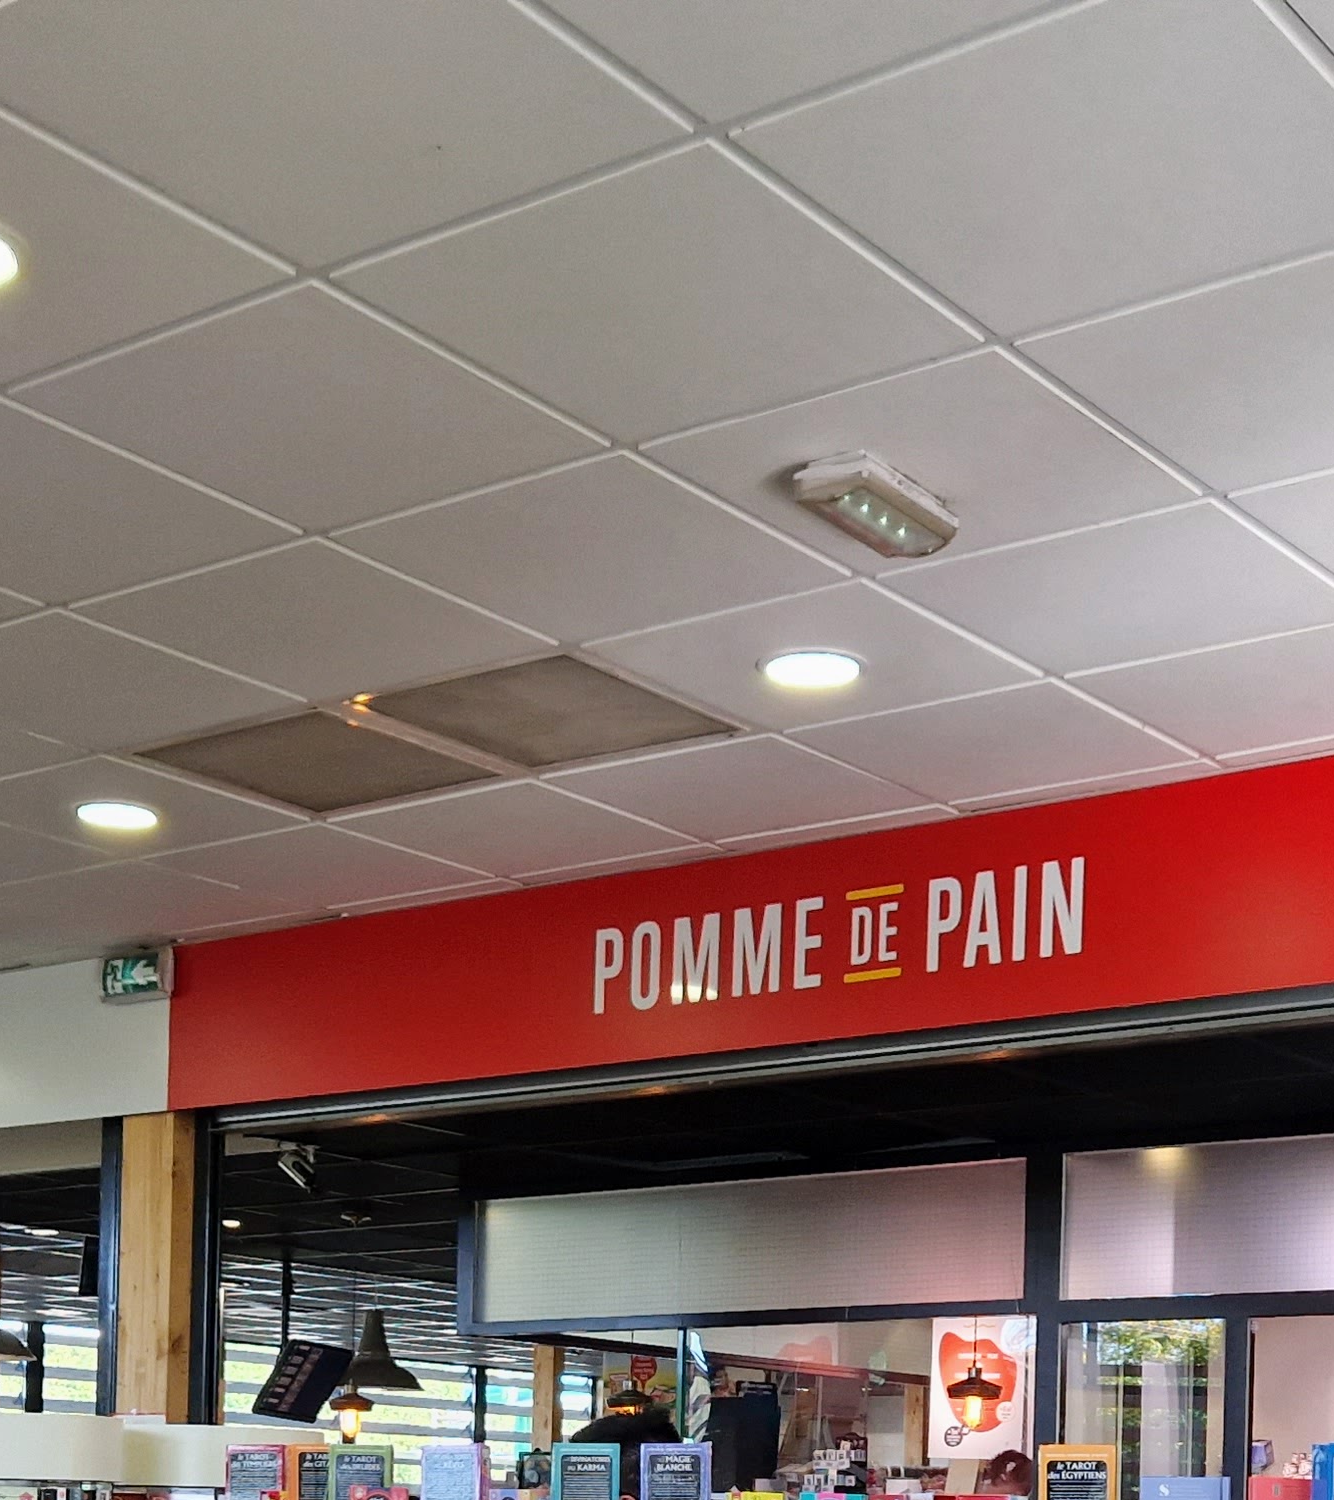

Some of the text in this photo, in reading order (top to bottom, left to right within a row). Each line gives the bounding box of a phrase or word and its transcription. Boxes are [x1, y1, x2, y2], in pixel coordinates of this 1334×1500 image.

[594, 857, 1085, 1016] POMME DE PAIN
[577, 1464, 606, 1472] KARMA
[657, 1464, 693, 1472] BLANCHE
[1067, 1462, 1097, 1470] TAROT
[1061, 1471, 1106, 1479] ÉGYPTIENS
